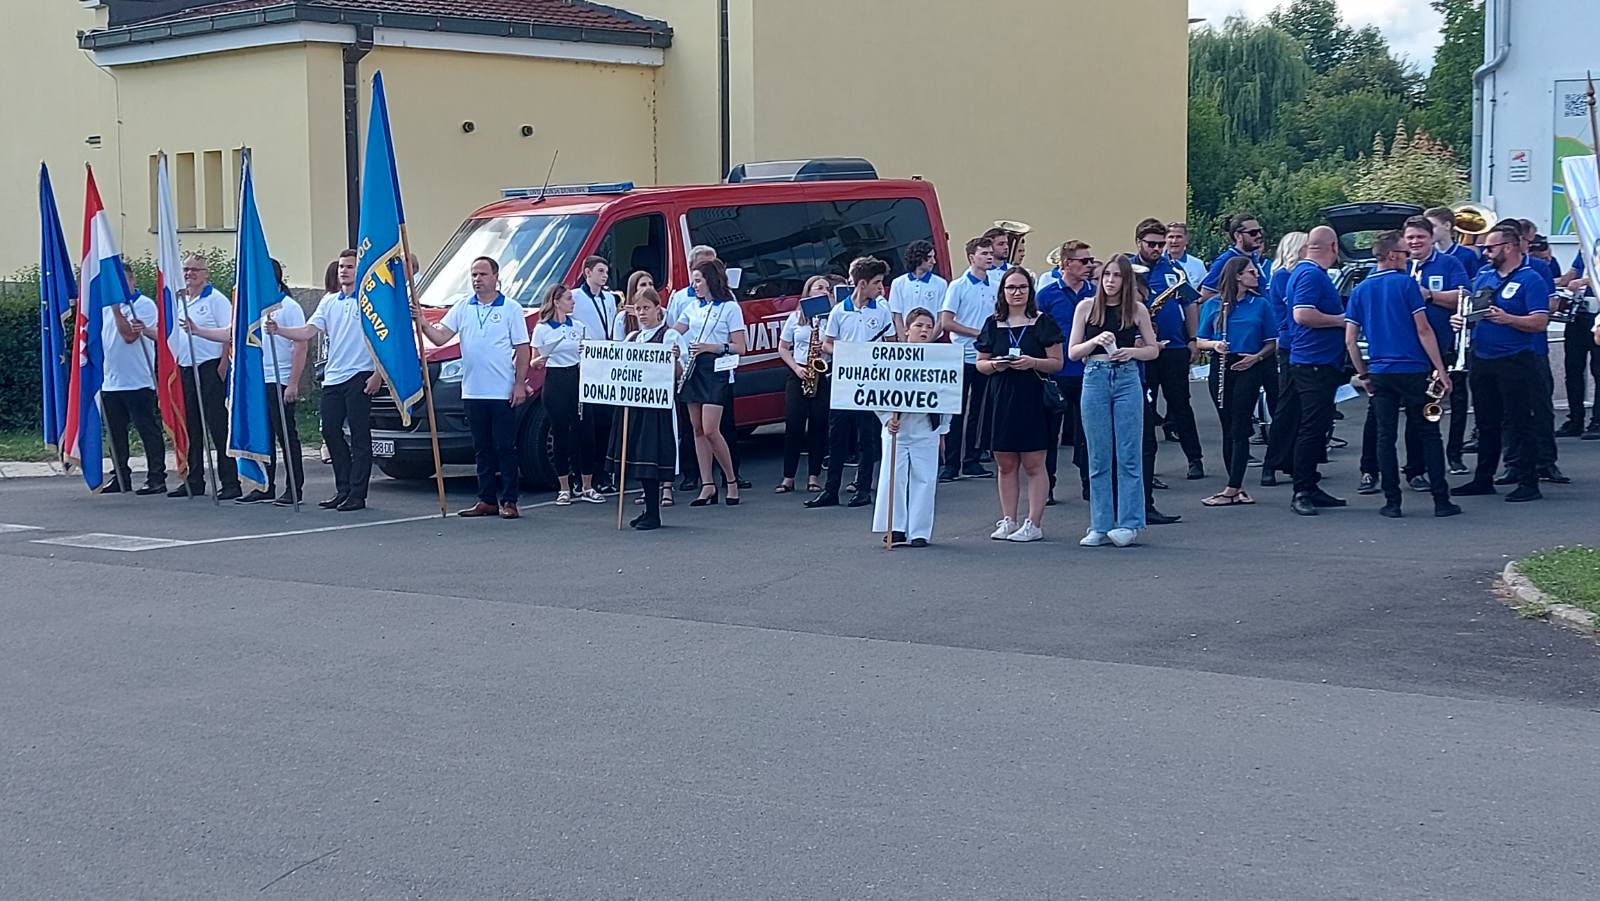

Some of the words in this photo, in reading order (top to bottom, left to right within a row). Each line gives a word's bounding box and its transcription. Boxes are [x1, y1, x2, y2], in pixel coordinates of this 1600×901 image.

[585, 344, 624, 360] PUHAČKI
[626, 348, 672, 364] ORKESTAR
[872, 346, 924, 361] GRADSKI
[610, 365, 643, 382] OPĆINE
[838, 364, 890, 381] PUHAČKI
[894, 368, 957, 384] ORKESTAR
[583, 383, 616, 401] DONJA
[620, 385, 669, 405] DUBRAVA
[854, 383, 939, 408] ČAKOVEC
